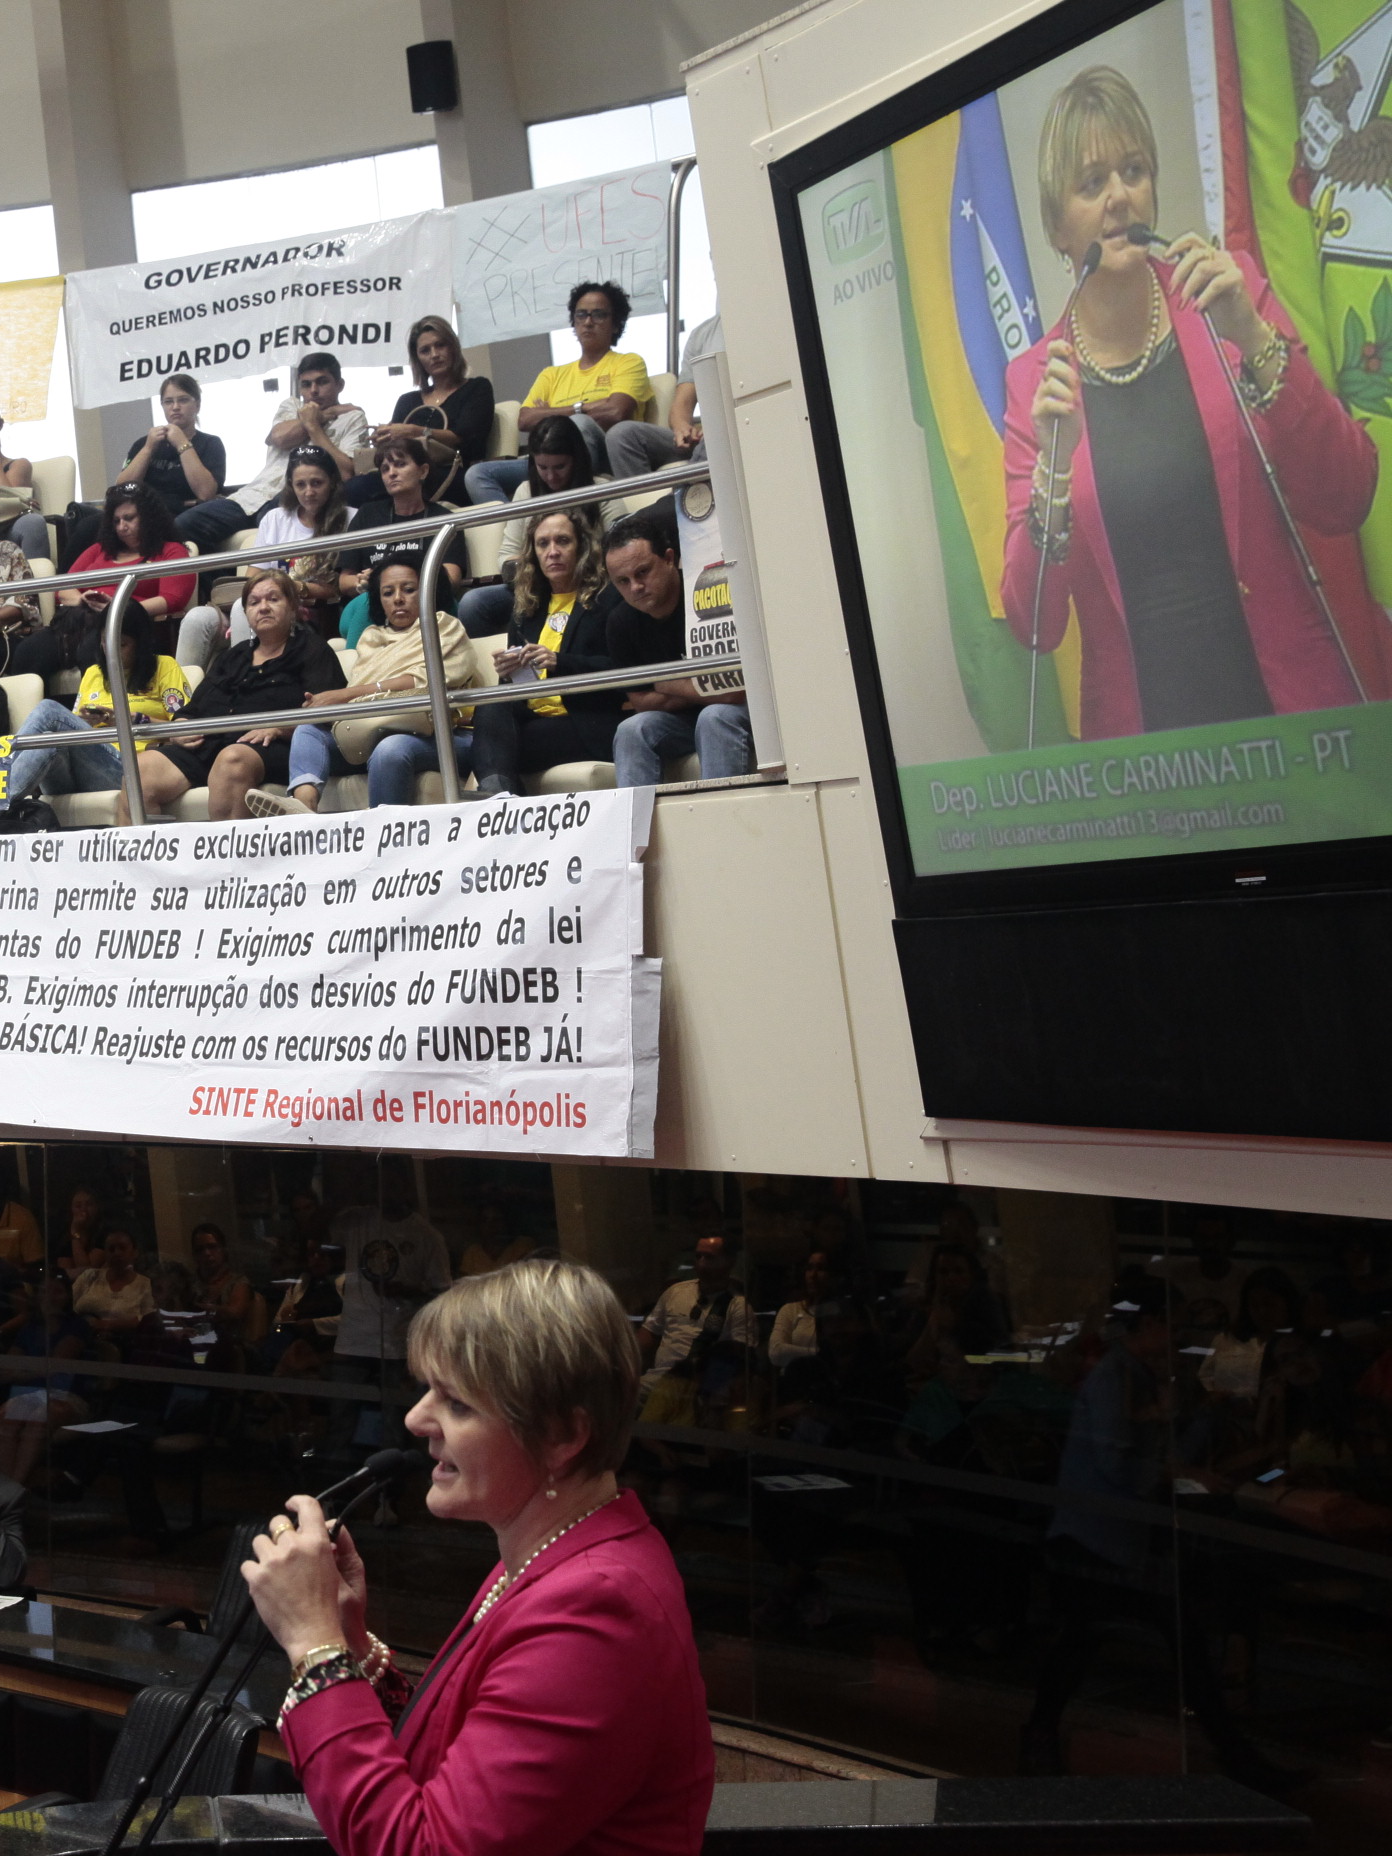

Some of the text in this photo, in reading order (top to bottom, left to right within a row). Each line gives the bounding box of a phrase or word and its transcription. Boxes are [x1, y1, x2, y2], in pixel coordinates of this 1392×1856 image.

[143, 238, 346, 291] GOVERNADOR
[833, 260, 895, 306] AO VIVO
[109, 275, 403, 337] QUEREMOS NOSSO PROFESSOR
[985, 265, 1022, 350] PRO
[119, 321, 394, 383] EDUARDO PERONDI
[930, 730, 1352, 819] Dep. LUCIANE CARMINATTI PT
[29, 839, 63, 863] ser
[78, 831, 180, 863] utilizados
[194, 820, 364, 859] exclusivamente
[378, 817, 431, 857] para
[447, 816, 462, 843] a
[477, 792, 591, 840] educação
[988, 801, 1284, 848] lucianecarminatti13@gmail.com
[54, 879, 137, 918] permite
[150, 886, 189, 911] sua
[204, 873, 306, 915] utilização
[323, 879, 356, 905] em
[372, 868, 442, 901] outros
[461, 856, 548, 894] setores
[566, 855, 582, 884] e
[55, 928, 81, 959] do
[95, 929, 181, 959] FUNDEB
[216, 926, 314, 966] Exigimos
[328, 916, 481, 961] cumprimento
[496, 909, 526, 945] da
[549, 906, 583, 944] lei
[24, 976, 118, 1014] Exigimos
[126, 975, 248, 1016] interrupção
[311, 973, 397, 1008] desvios
[445, 967, 559, 1004] FUNDEB
[90, 1025, 186, 1065] Reajuste
[190, 1034, 237, 1061] com
[242, 1036, 269, 1061] os
[275, 1033, 372, 1062] recursos
[417, 1025, 531, 1062] FUNDEB
[540, 1013, 583, 1063] JÁ!
[189, 1086, 587, 1135] SINTE Regional Florianópolis
